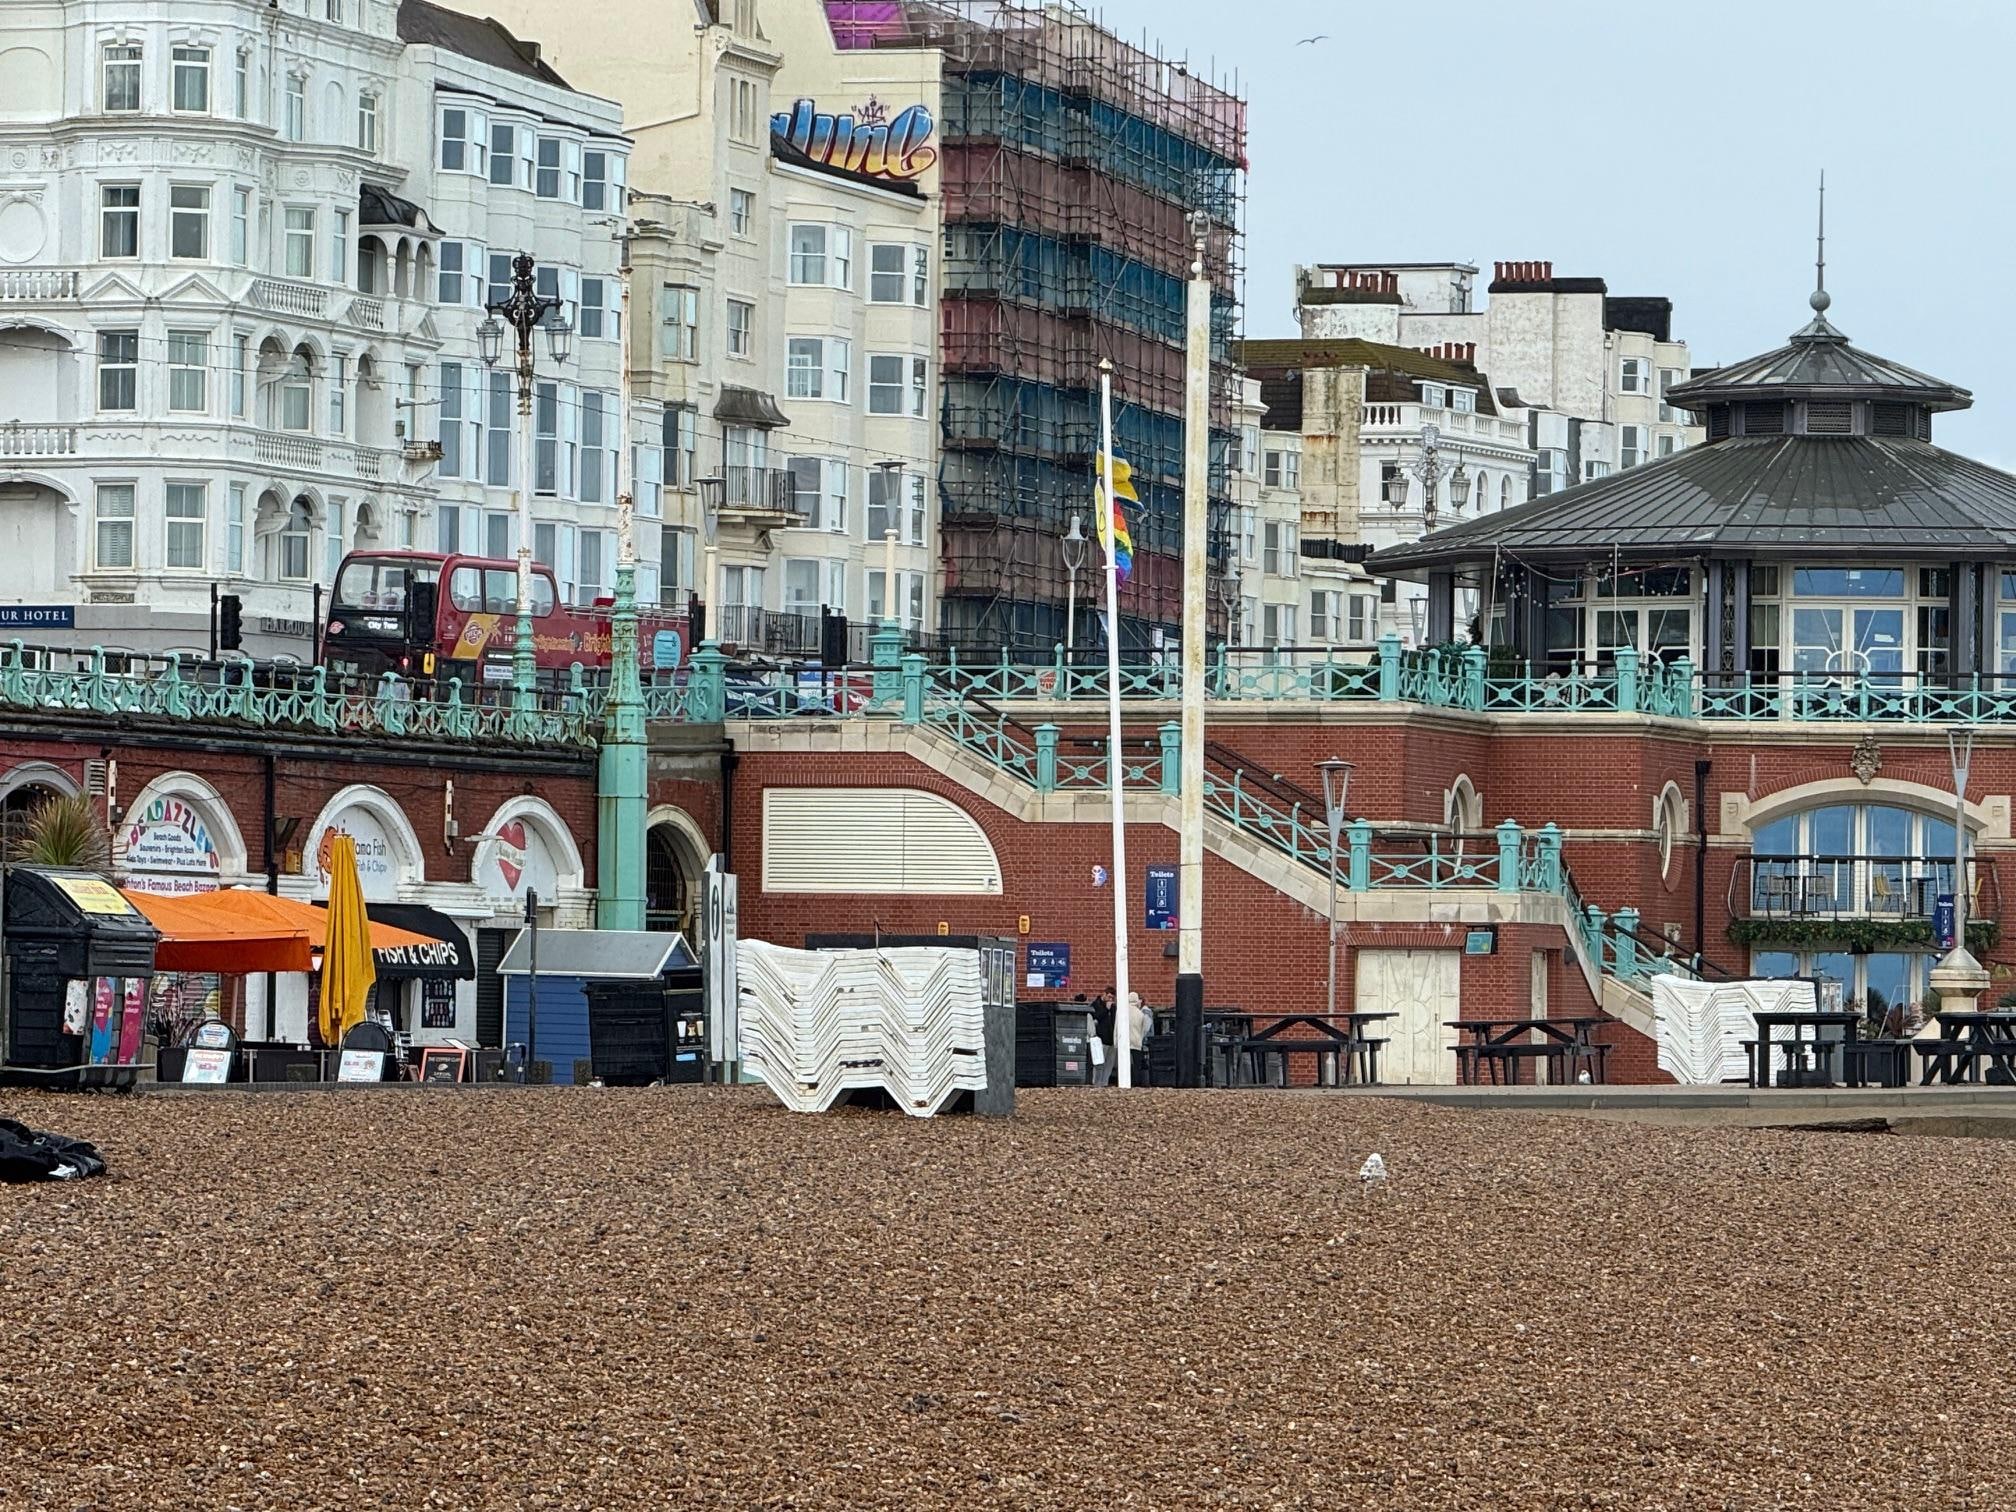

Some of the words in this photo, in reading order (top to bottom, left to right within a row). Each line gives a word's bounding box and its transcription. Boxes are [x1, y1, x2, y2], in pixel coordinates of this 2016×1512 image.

[24, 611, 68, 620] HOTEL
[164, 845, 184, 855] Brighton
[373, 838, 387, 857] Fish
[147, 879, 172, 891] Famous
[174, 880, 194, 892] Beach
[195, 880, 217, 893] Bazaar
[377, 947, 407, 964] FISH
[407, 945, 419, 965] &
[419, 941, 459, 966] CHIPS
